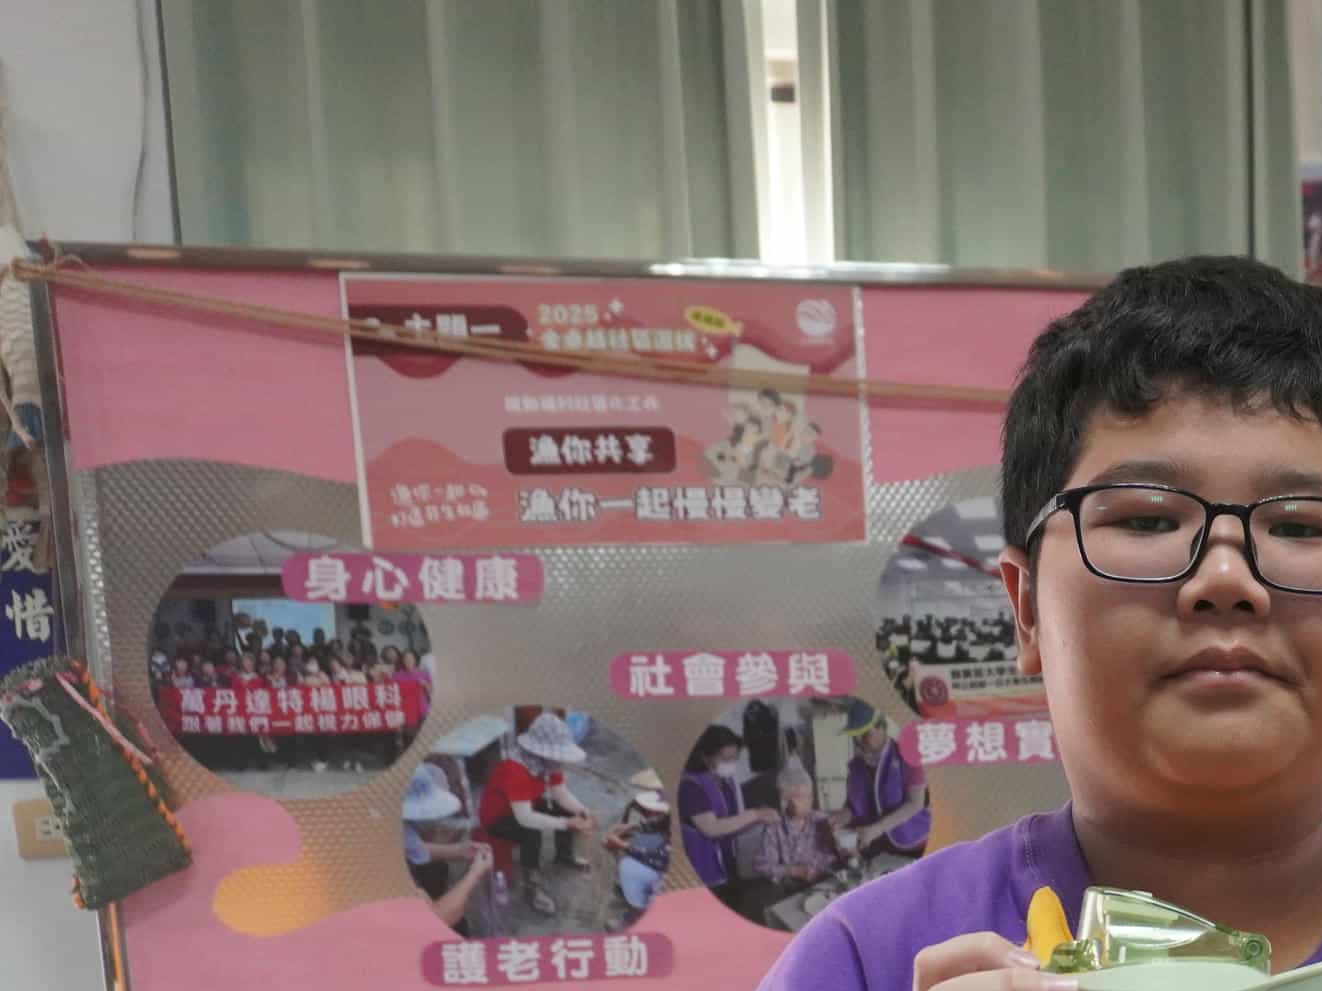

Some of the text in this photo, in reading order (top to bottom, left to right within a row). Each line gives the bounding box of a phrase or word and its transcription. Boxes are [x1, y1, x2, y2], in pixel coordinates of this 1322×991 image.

[537, 303, 599, 326] 2025
[528, 433, 653, 466] 漁你共享
[518, 485, 820, 522] 漁你一起慢慢變老
[304, 555, 519, 600] 身心健康
[629, 652, 831, 696] 社會參與
[441, 935, 649, 985] 護老行動
